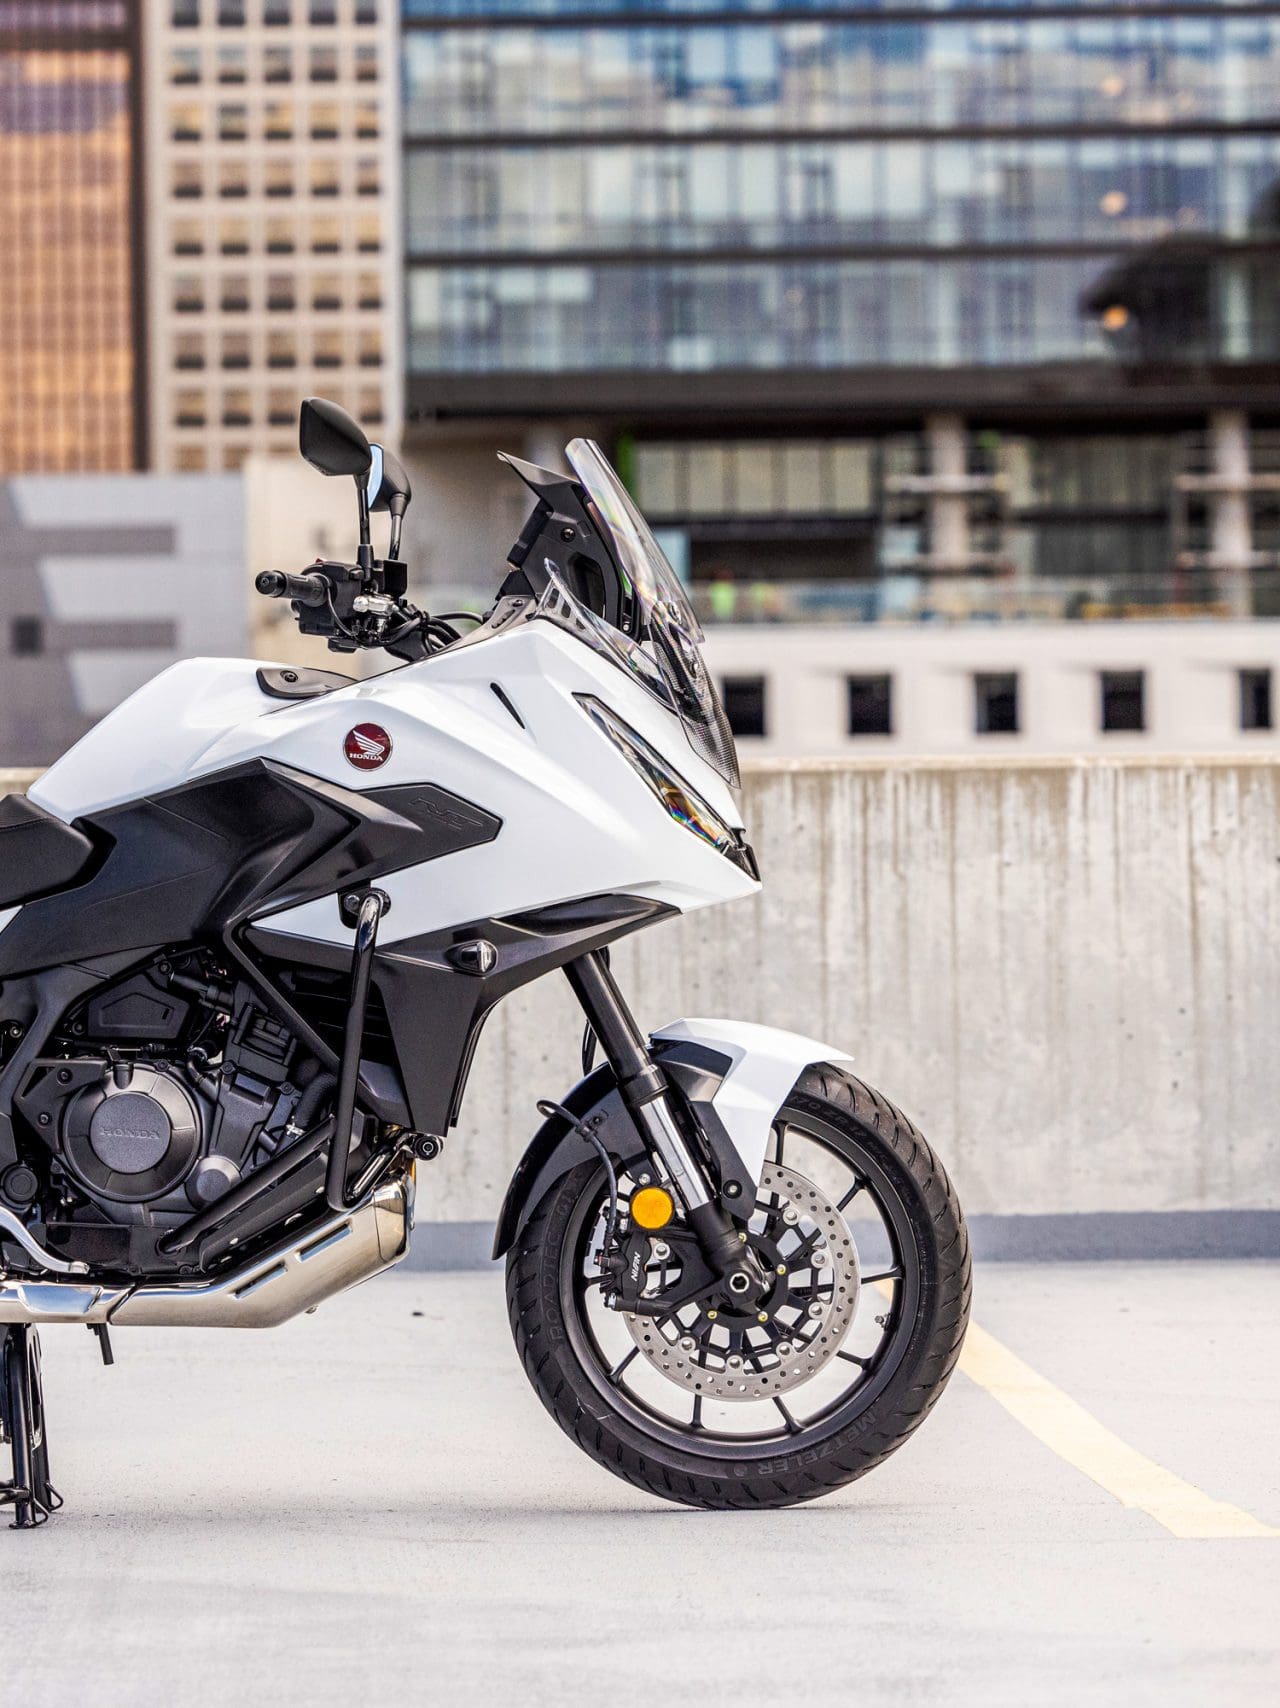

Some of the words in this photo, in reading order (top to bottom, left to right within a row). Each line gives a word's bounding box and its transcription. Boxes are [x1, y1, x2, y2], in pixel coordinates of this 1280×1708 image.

[349, 752, 384, 761] HONDA
[99, 1126, 160, 1140] HONDA
[543, 1230, 564, 1341] ROADTEC
[757, 1410, 877, 1475] METZELER
